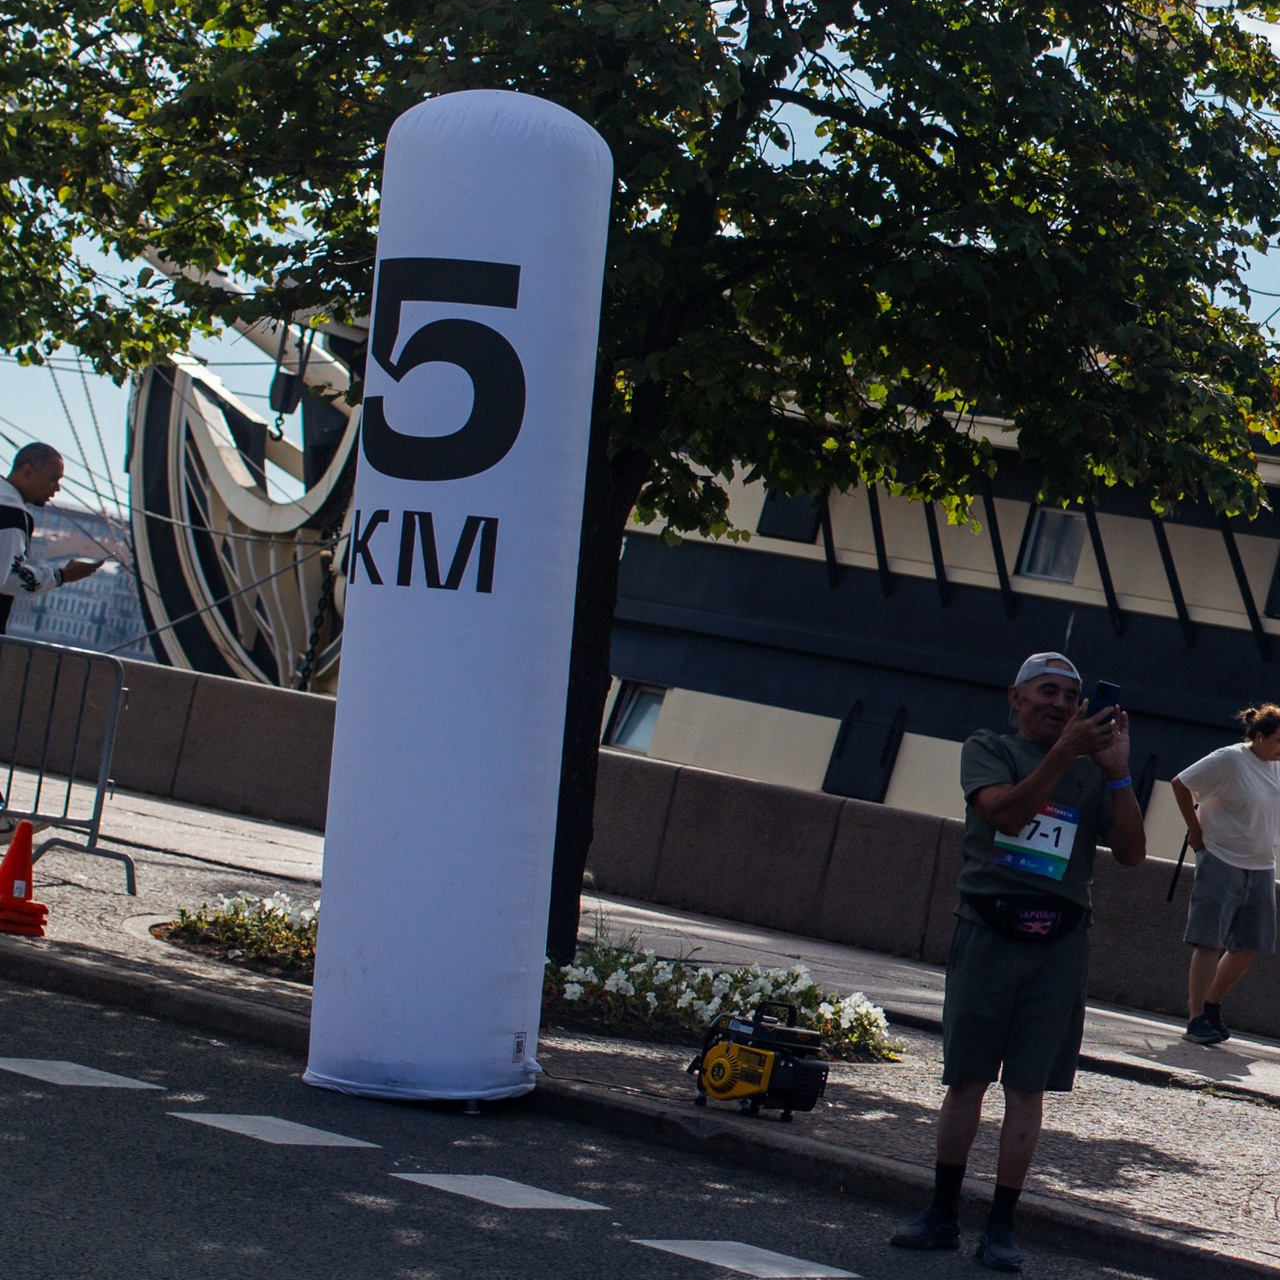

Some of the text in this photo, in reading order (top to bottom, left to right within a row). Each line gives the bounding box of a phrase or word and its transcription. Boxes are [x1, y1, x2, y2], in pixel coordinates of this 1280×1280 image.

[362, 256, 527, 482] 5
[349, 509, 500, 594] KM
[1015, 819, 1062, 848] 7-1
